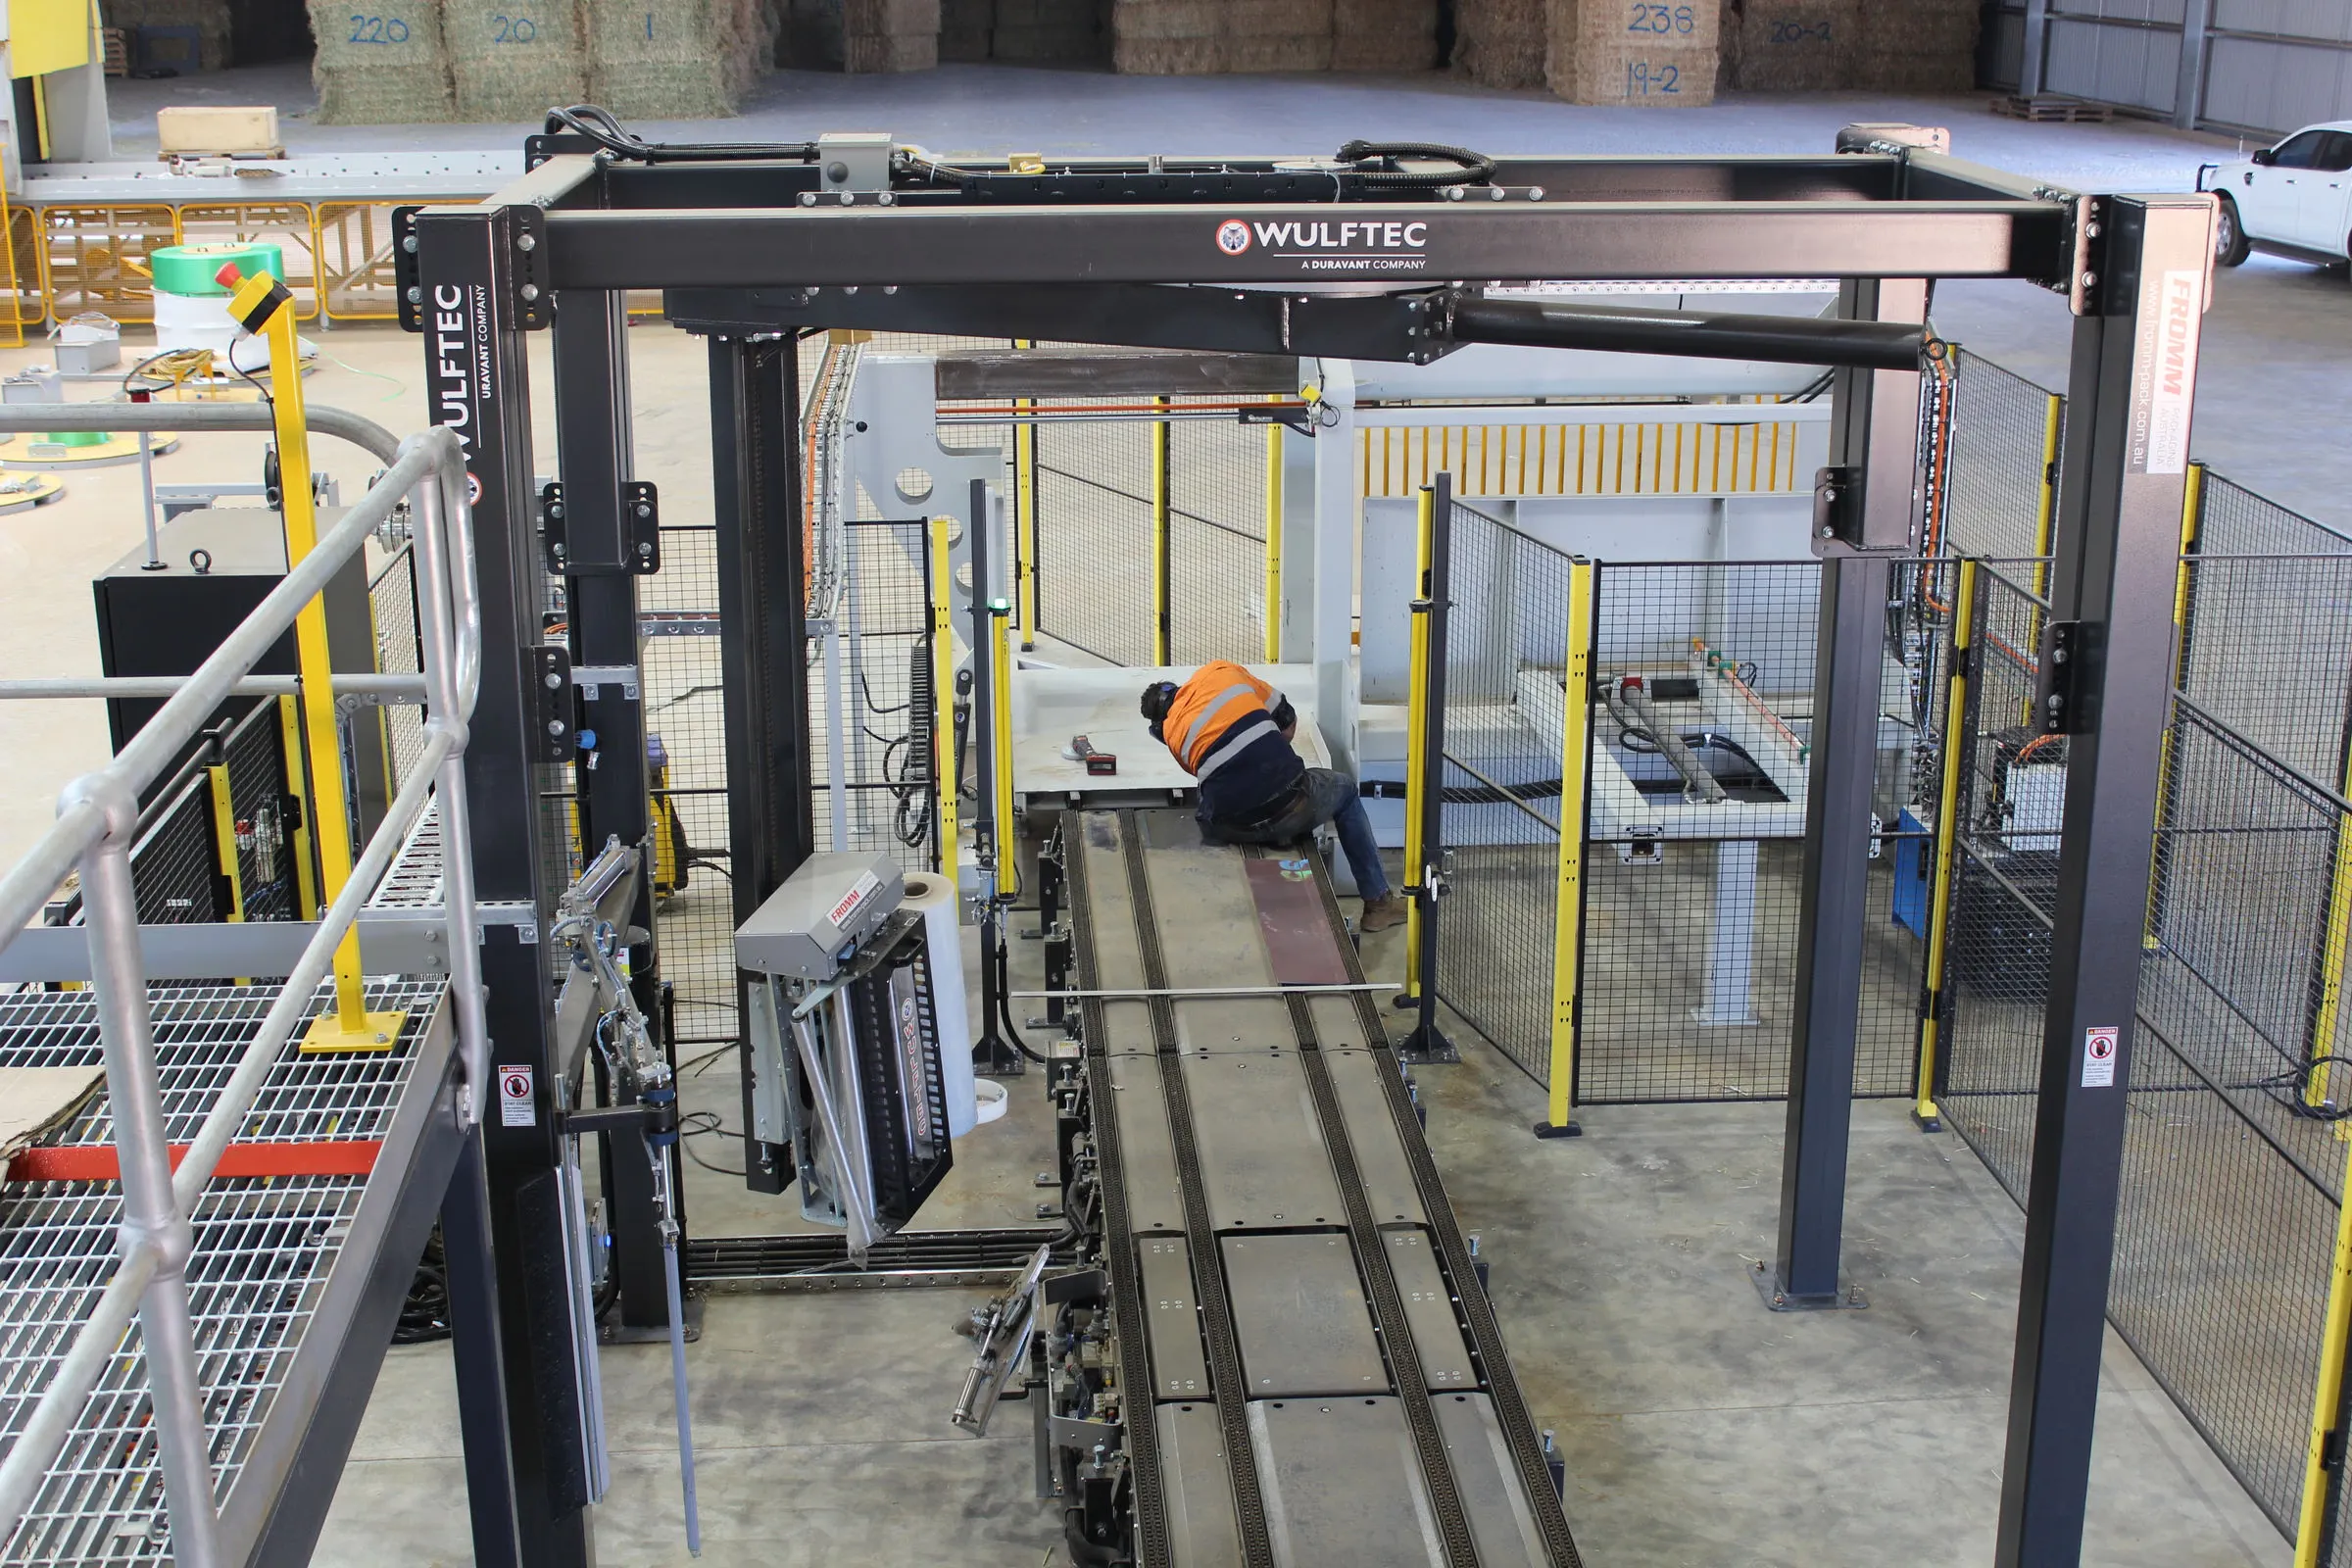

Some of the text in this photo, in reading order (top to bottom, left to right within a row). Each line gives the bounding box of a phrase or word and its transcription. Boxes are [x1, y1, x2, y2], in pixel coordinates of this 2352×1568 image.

[349, 15, 409, 44] 220
[493, 16, 535, 43] 20
[1628, 3, 1694, 34] 238
[1626, 62, 1680, 97] 19-2
[1253, 222, 1427, 247] WULFTEC
[1301, 260, 1426, 270] A DURAVANT COMPANY
[475, 284, 491, 399] URAVANT COMPANY
[2163, 277, 2191, 396] FROMM
[435, 285, 471, 462] ULFTEC
[2132, 280, 2160, 466] www.fromm-pack.com.au
[2156, 408, 2168, 466] AUSTRALIA
[831, 889, 859, 922] FROMM
